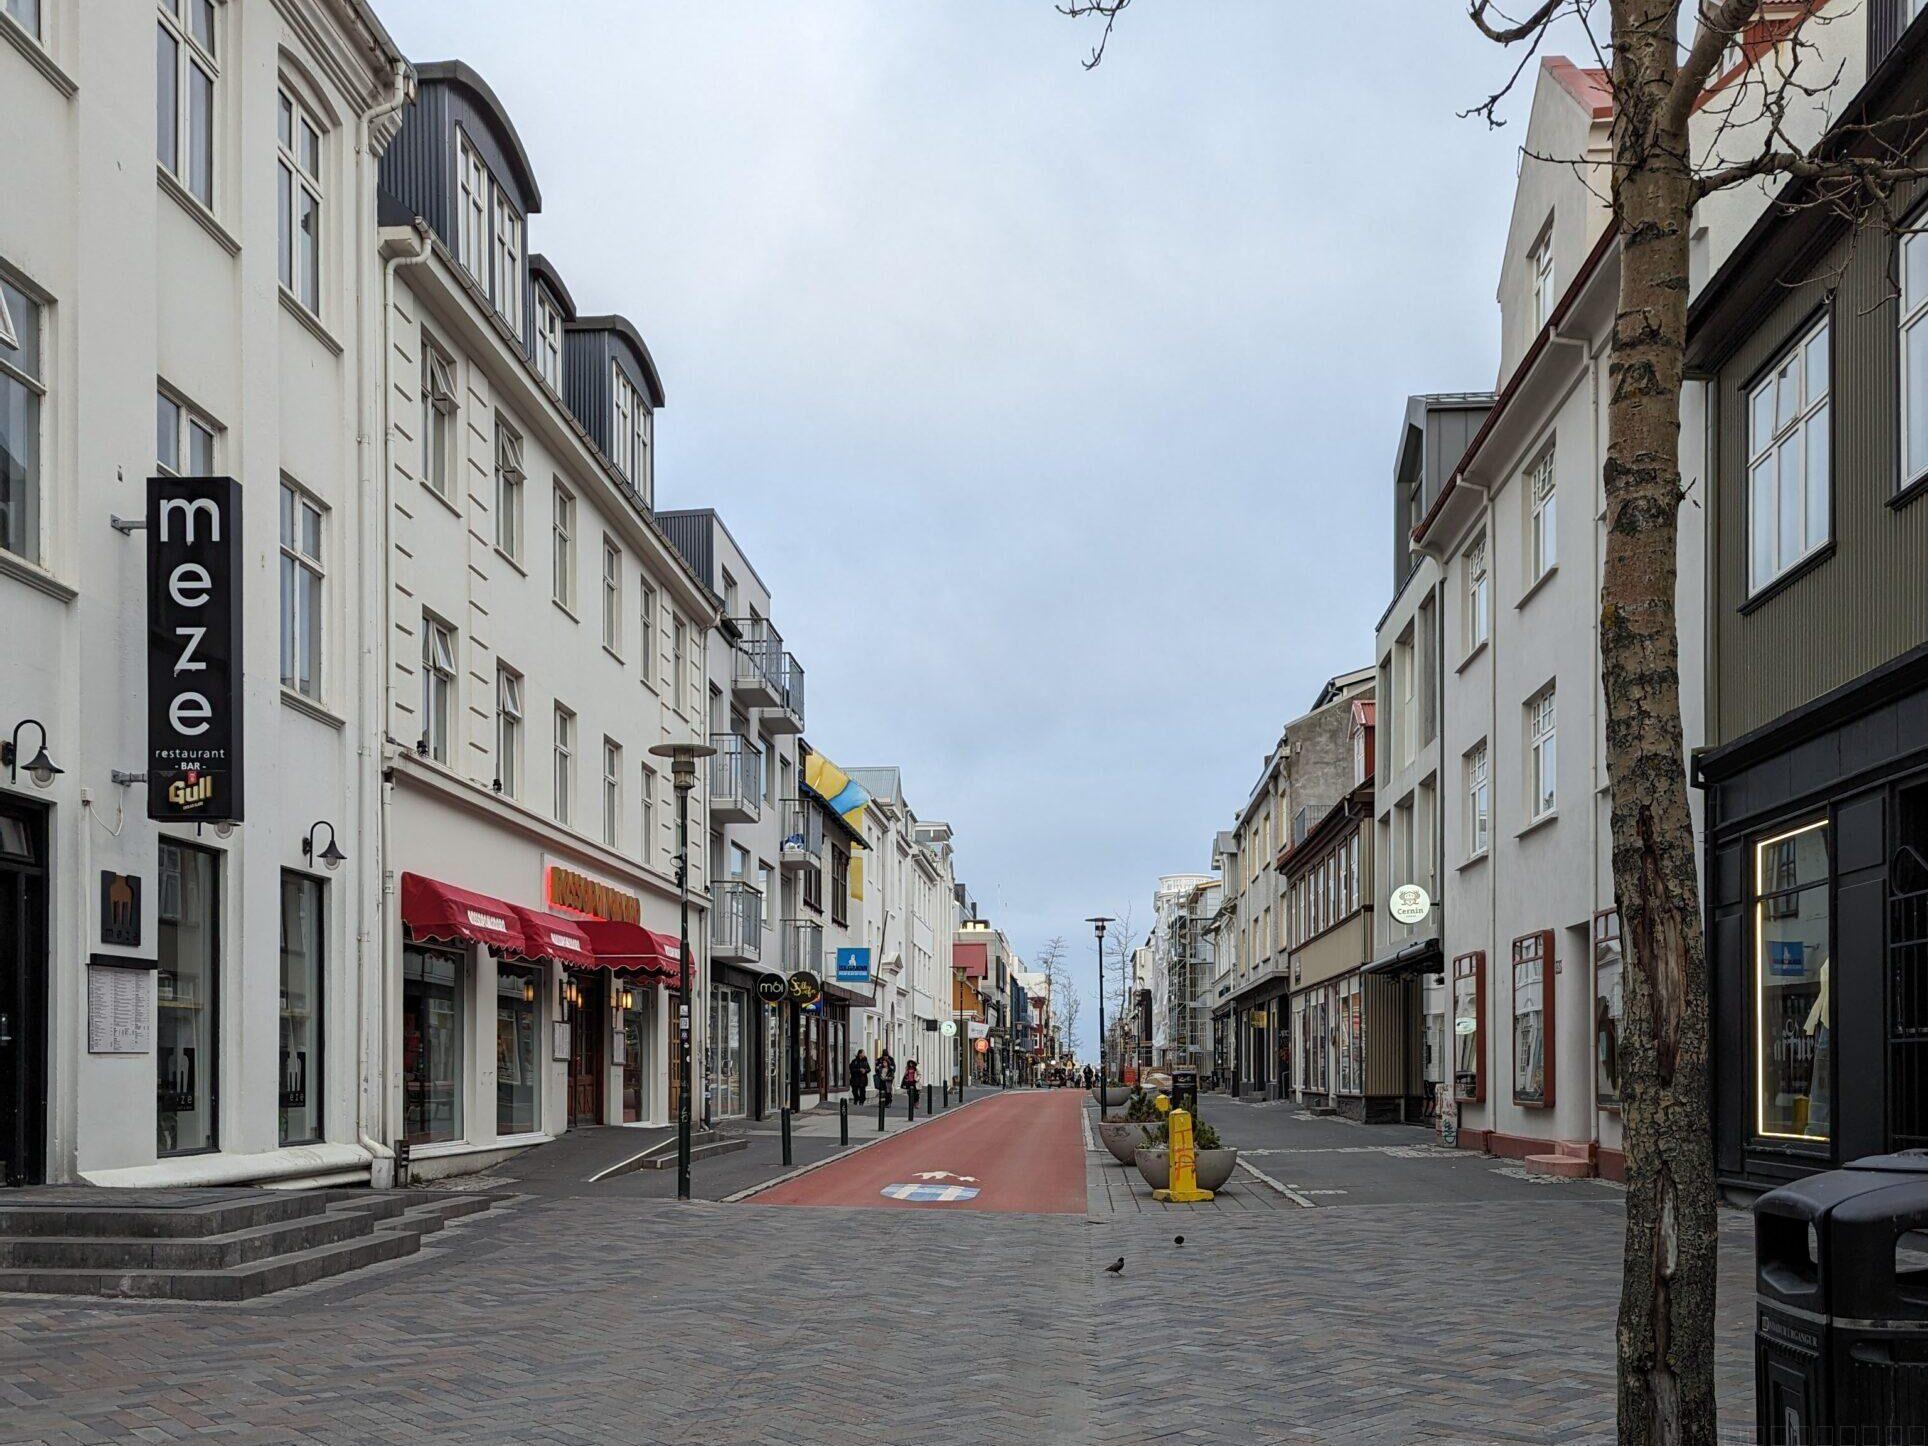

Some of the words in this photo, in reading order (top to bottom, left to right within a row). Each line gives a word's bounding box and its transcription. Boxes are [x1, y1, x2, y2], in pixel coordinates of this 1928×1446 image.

[159, 497, 220, 737] meze
[155, 748, 225, 759] restaurant
[181, 762, 201, 771] BAR
[168, 775, 213, 805] Gull
